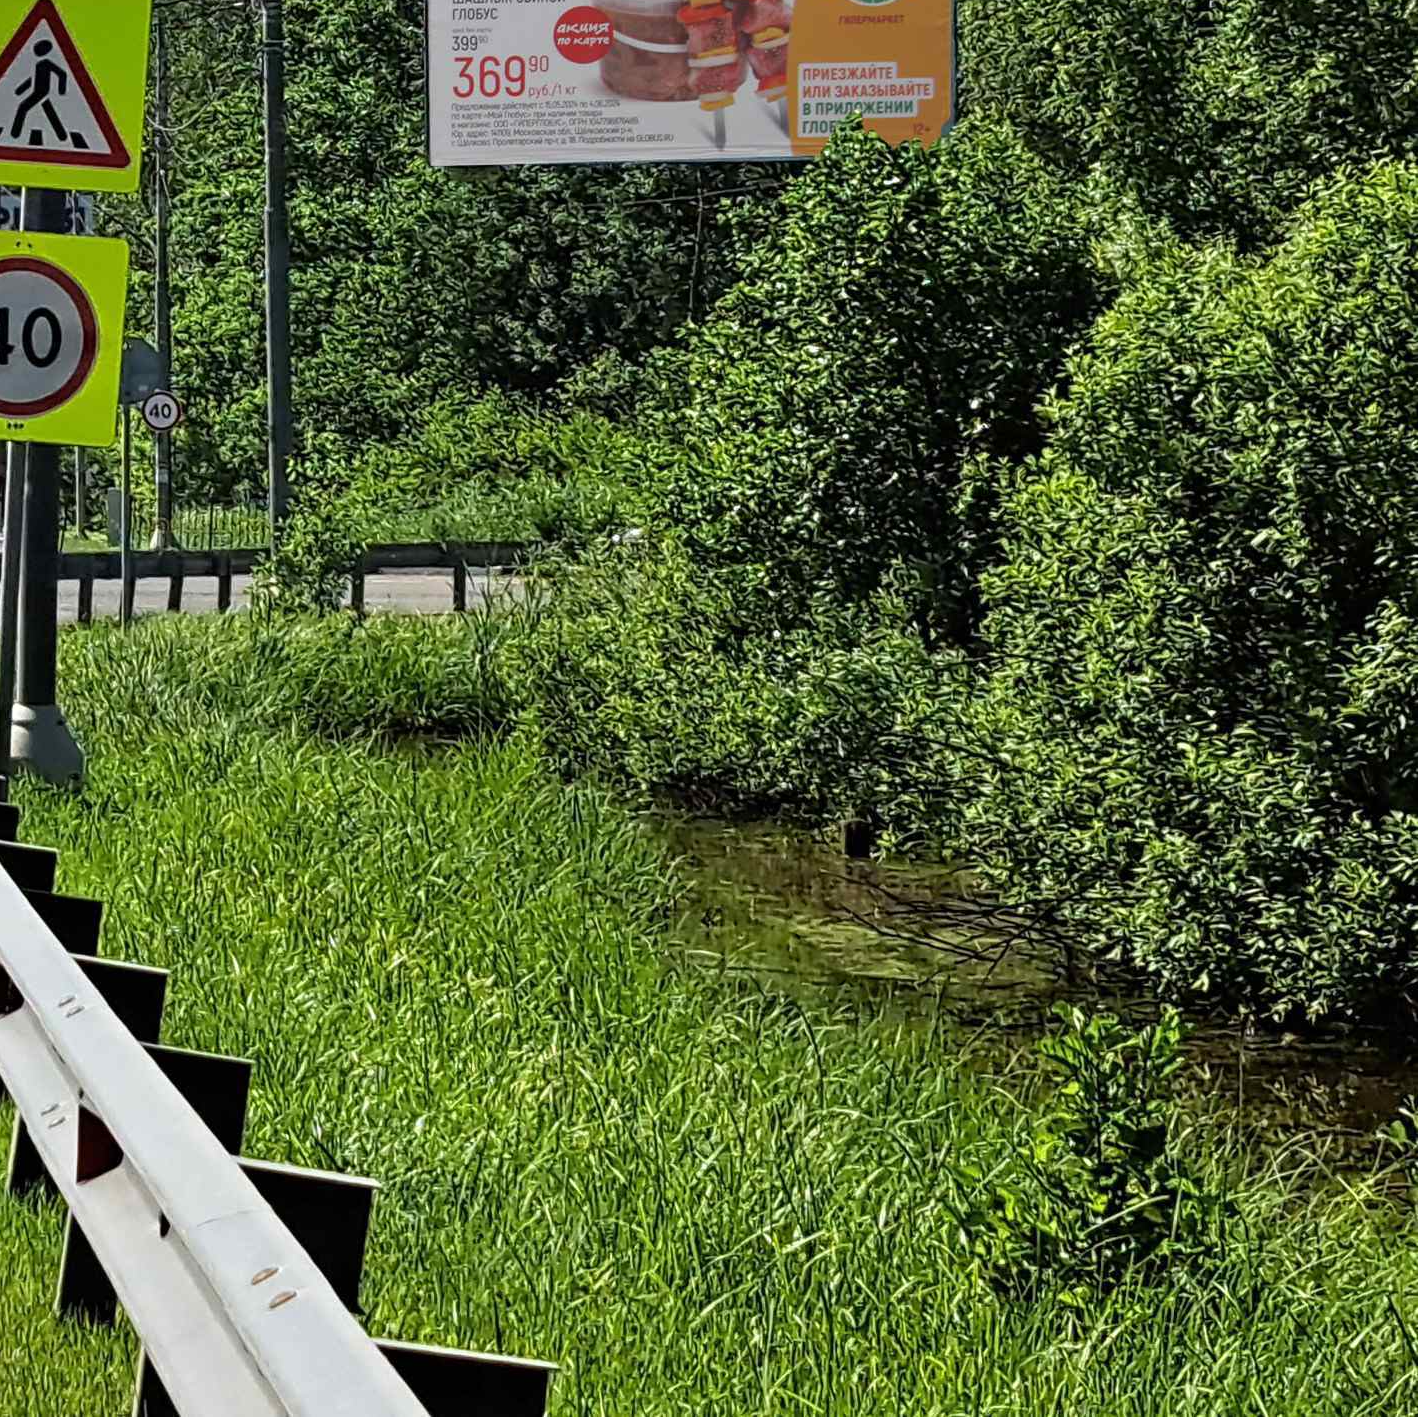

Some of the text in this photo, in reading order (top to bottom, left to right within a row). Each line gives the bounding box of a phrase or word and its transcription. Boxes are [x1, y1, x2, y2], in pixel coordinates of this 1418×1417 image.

[452, 7, 499, 21] ГЛОБУС
[452, 55, 549, 98] 369 90
[803, 63, 894, 80] ПРИЕЗЖАЙТЕ
[803, 81, 931, 98] ИЛИ ЗАКАЗЫВАЙТЕ
[803, 103, 812, 116] В
[149, 403, 171, 419] 40
